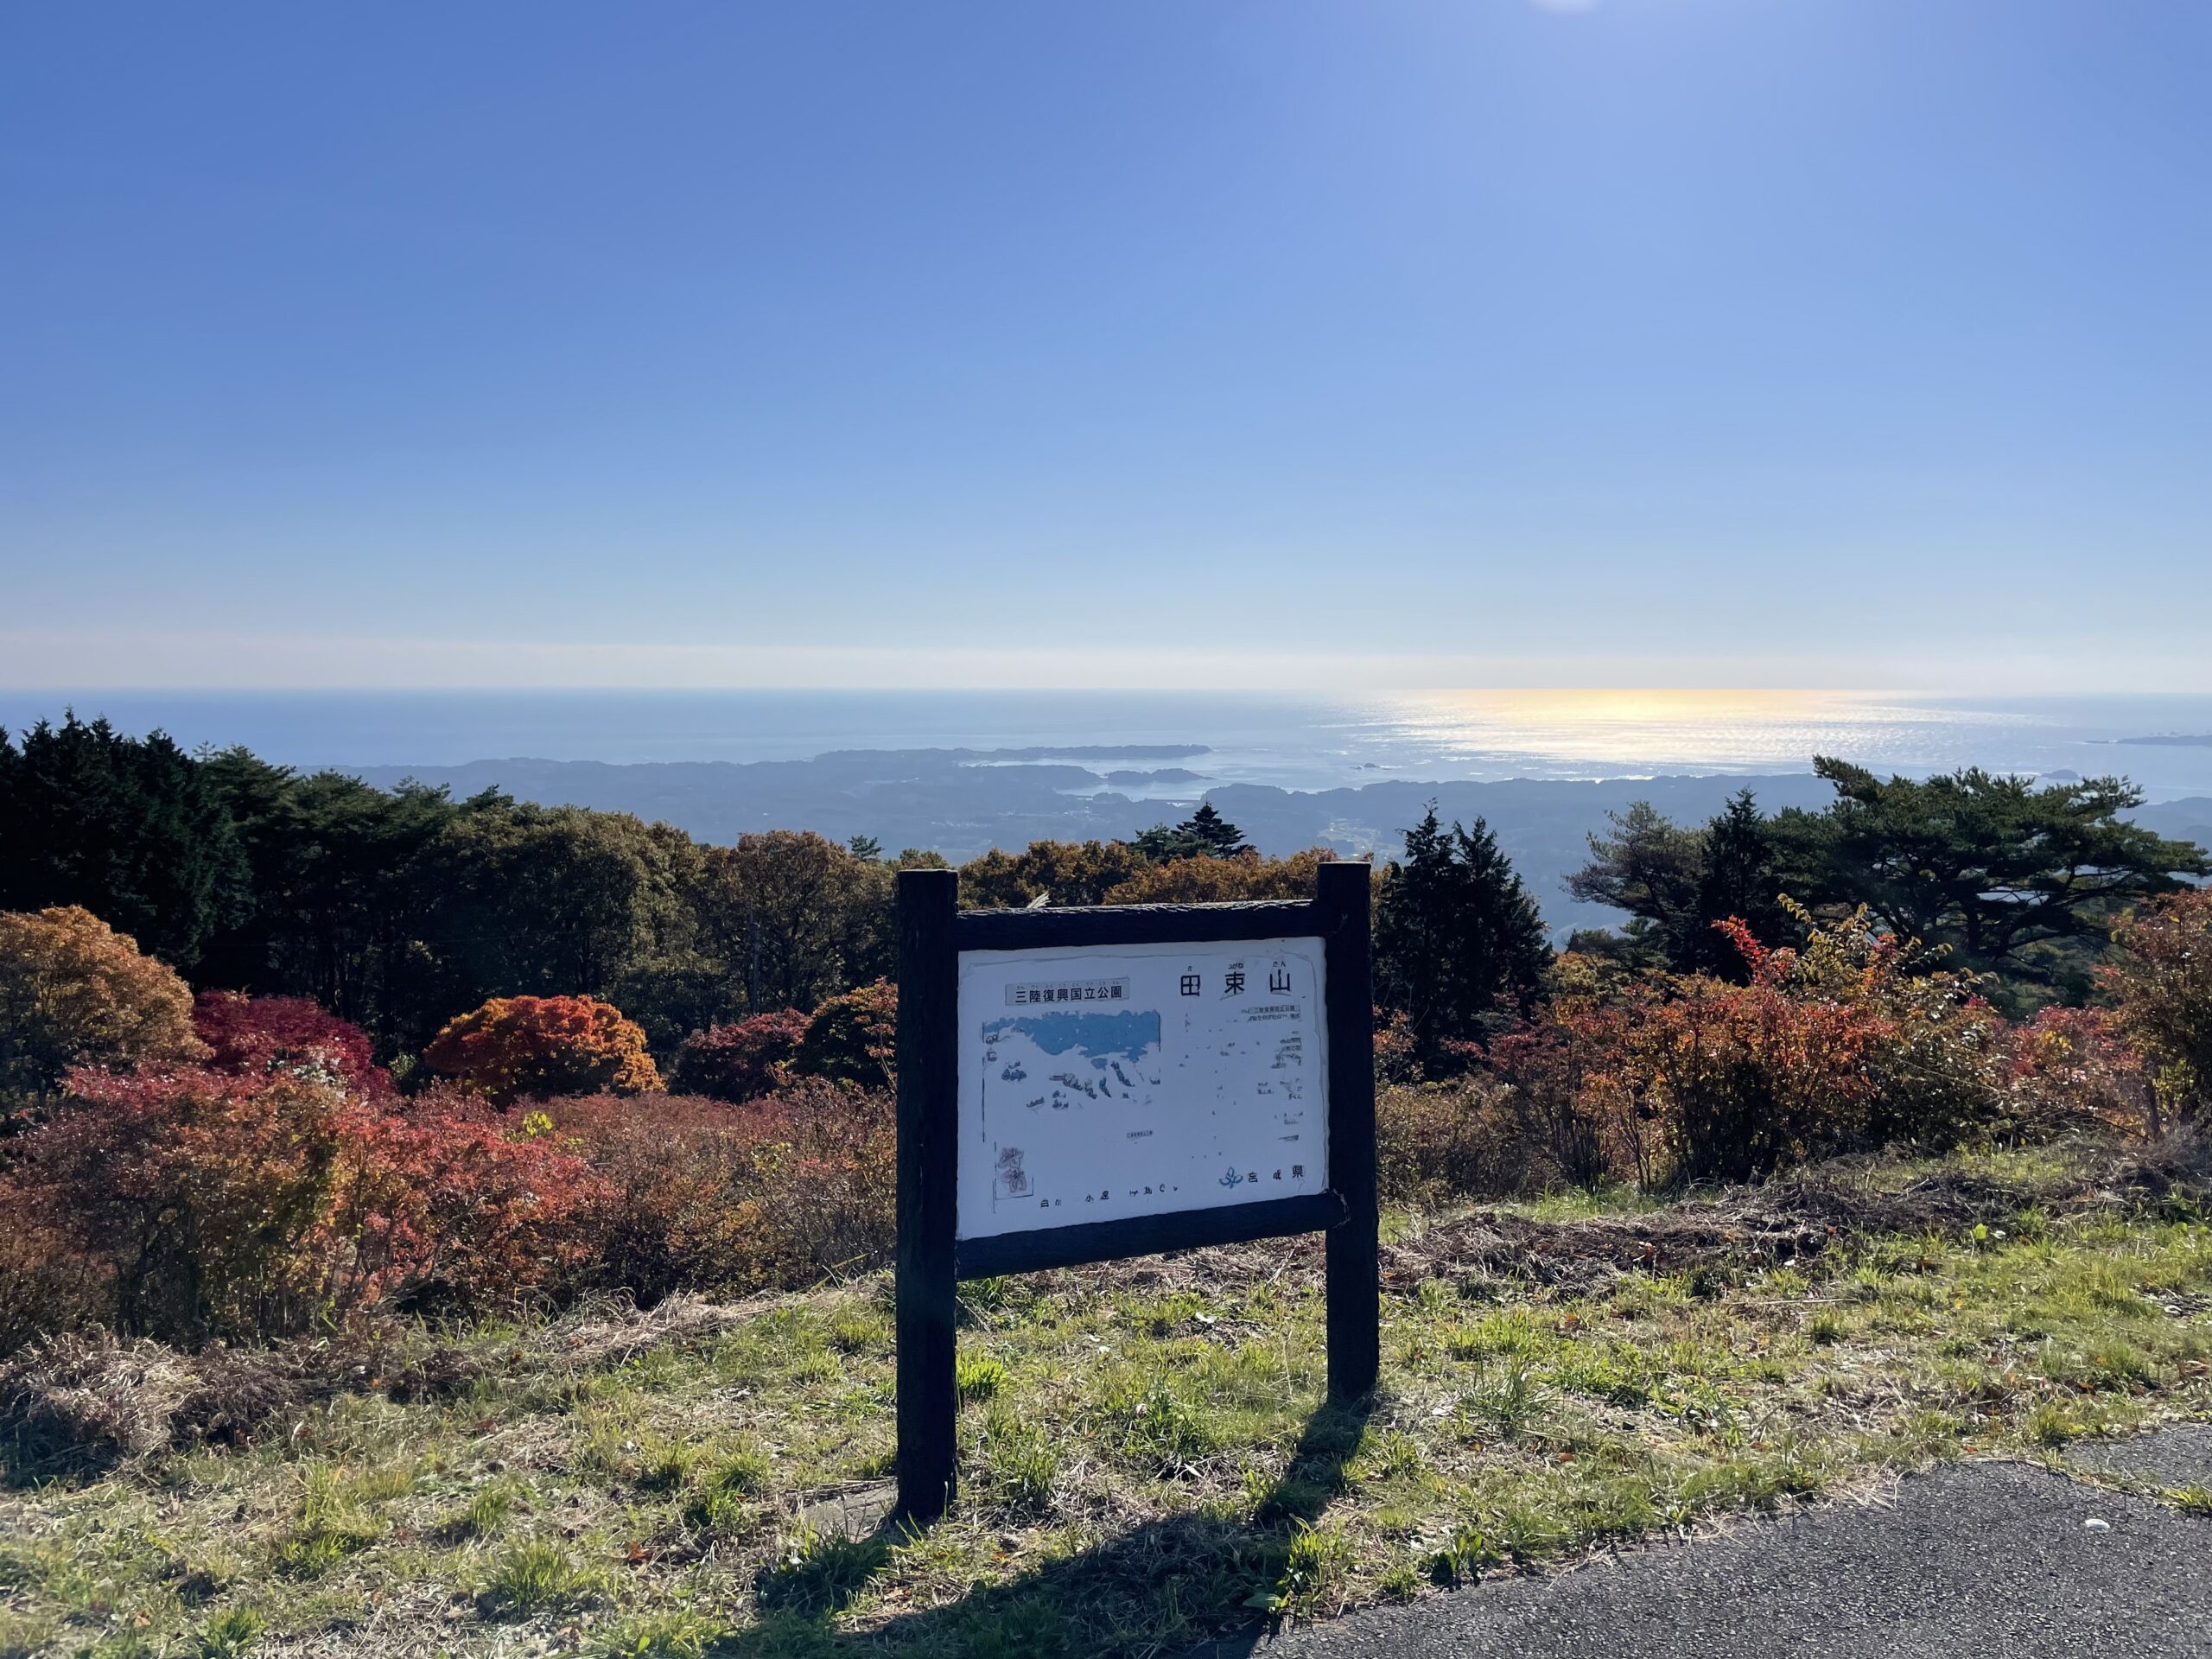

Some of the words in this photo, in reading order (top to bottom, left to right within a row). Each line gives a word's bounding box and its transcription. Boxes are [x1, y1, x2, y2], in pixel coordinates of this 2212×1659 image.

[1180, 969, 1291, 996] 田束山
[1014, 985, 1122, 1003] 三陸復興国立公園
